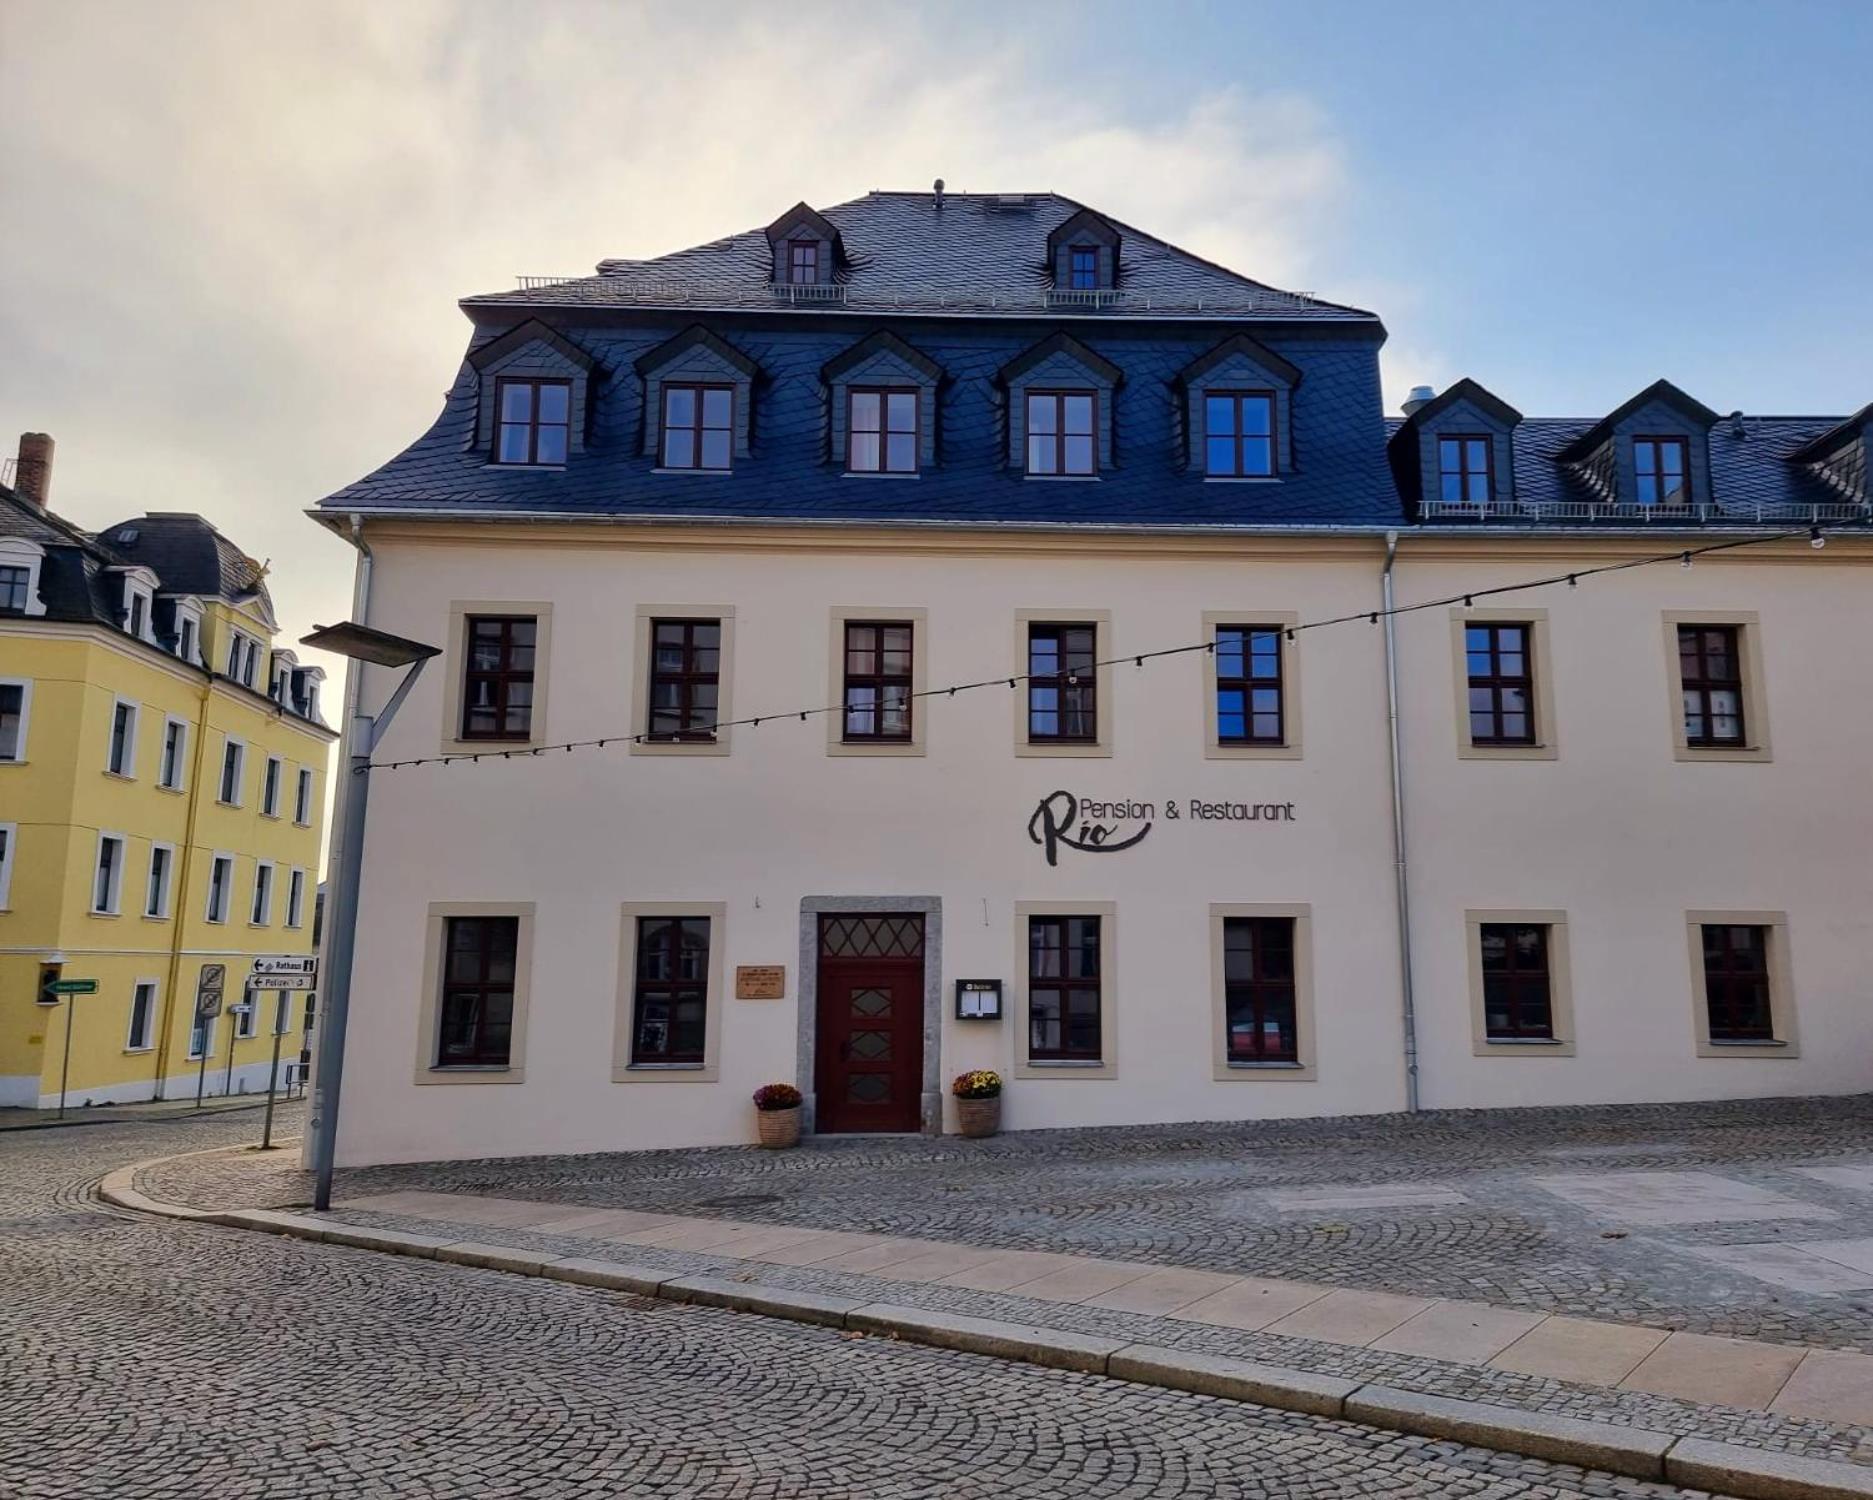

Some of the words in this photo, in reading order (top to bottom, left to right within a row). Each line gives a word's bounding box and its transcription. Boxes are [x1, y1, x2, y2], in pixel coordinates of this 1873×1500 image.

[1080, 798, 1155, 819] Pension
[1165, 800, 1180, 820] &
[1191, 799, 1296, 821] Restaurant
[1028, 790, 1152, 867] Rio
[276, 961, 302, 970] Rathaus
